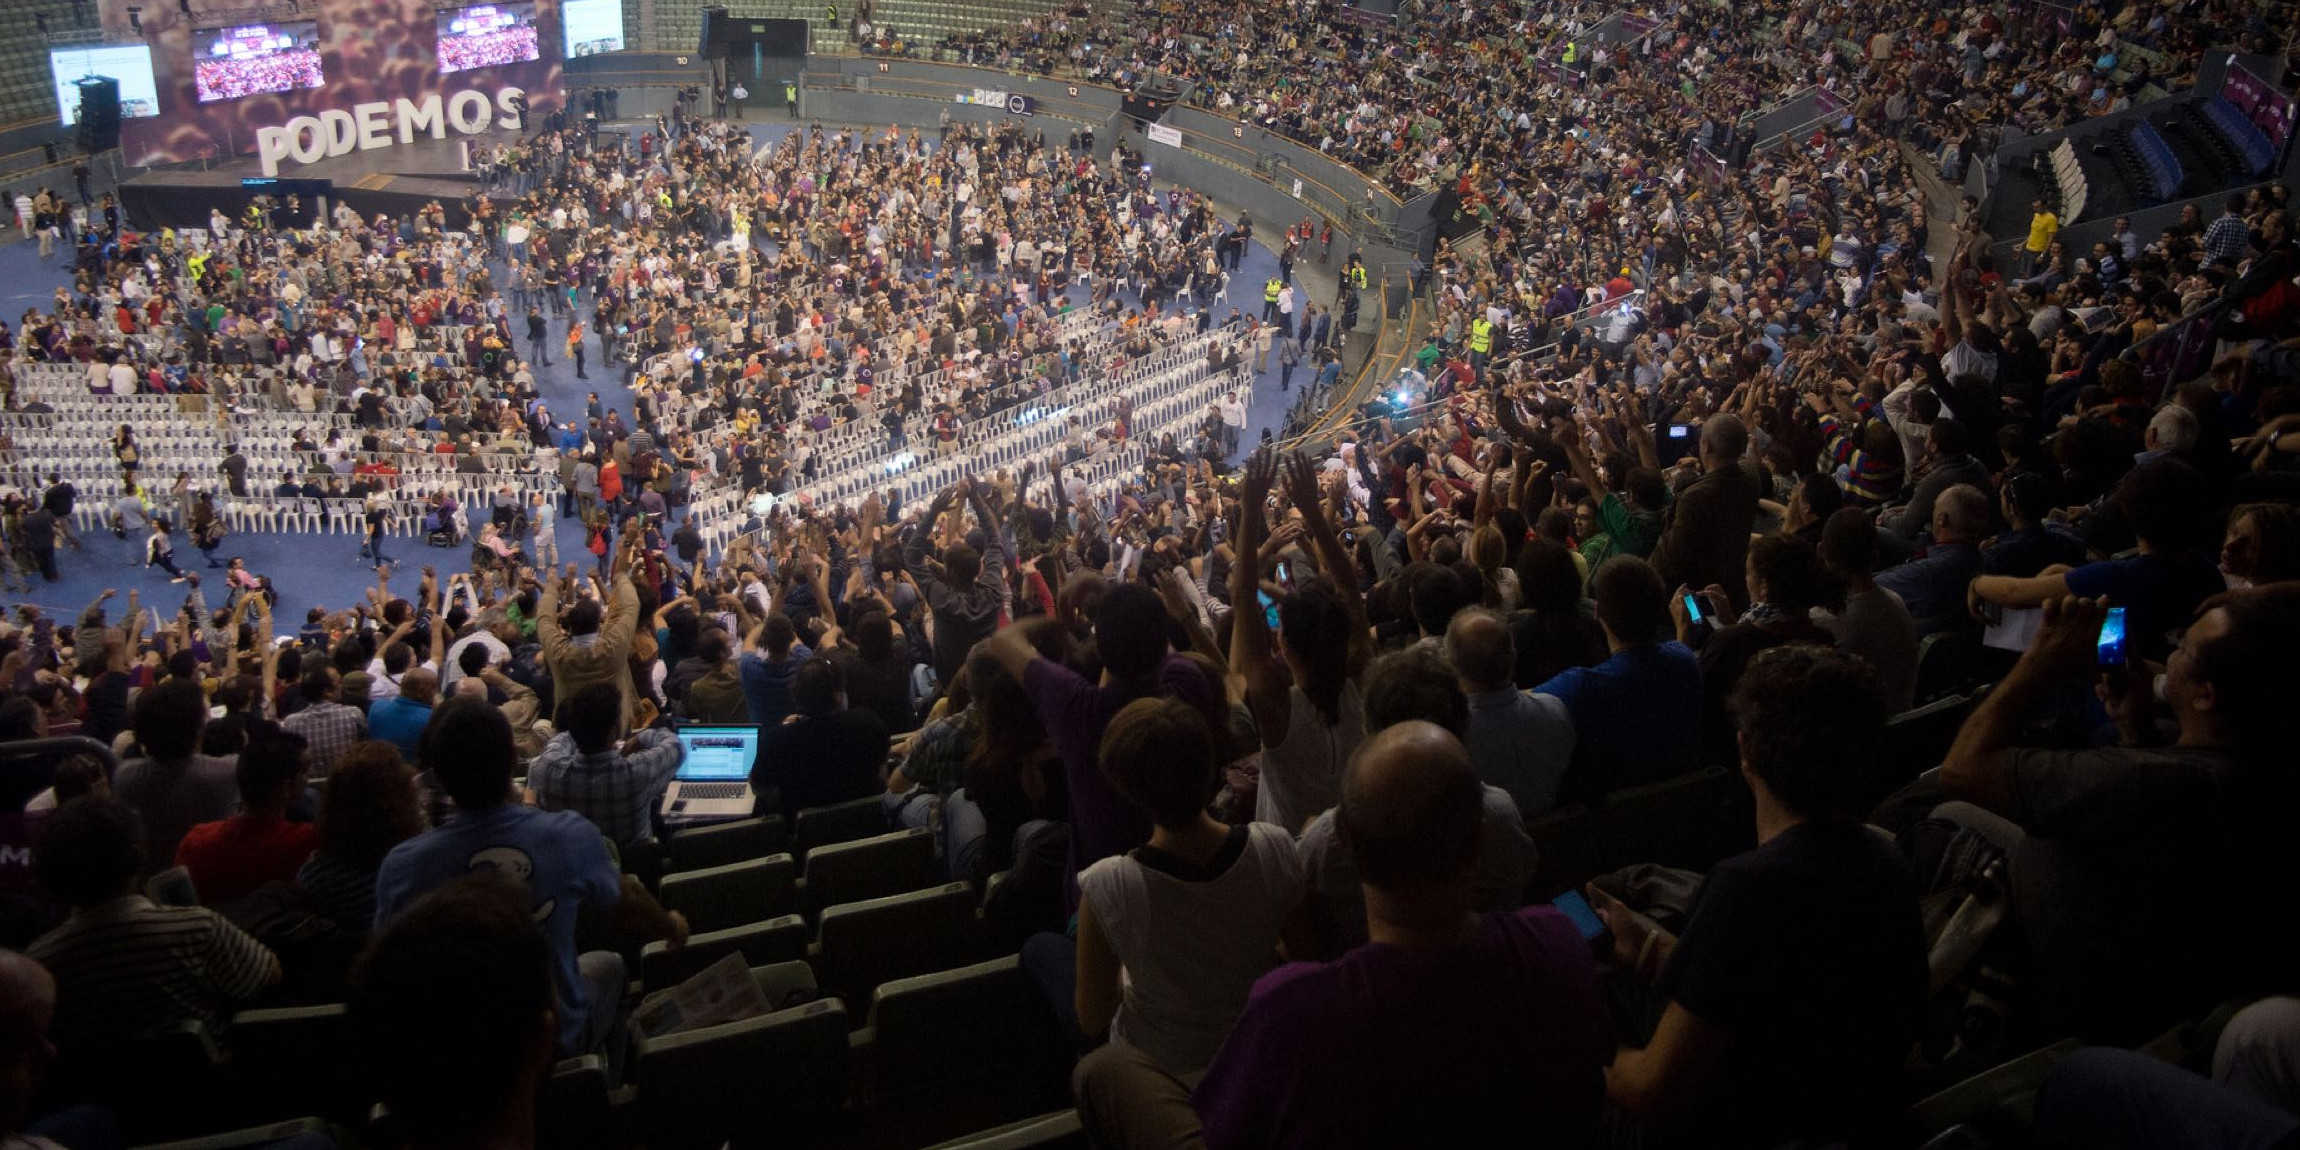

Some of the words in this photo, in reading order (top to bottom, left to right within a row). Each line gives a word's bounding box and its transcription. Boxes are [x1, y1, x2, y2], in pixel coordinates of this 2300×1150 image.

[676, 56, 688, 65] 10
[879, 63, 889, 72] 11
[256, 87, 526, 178] PODEMOS
